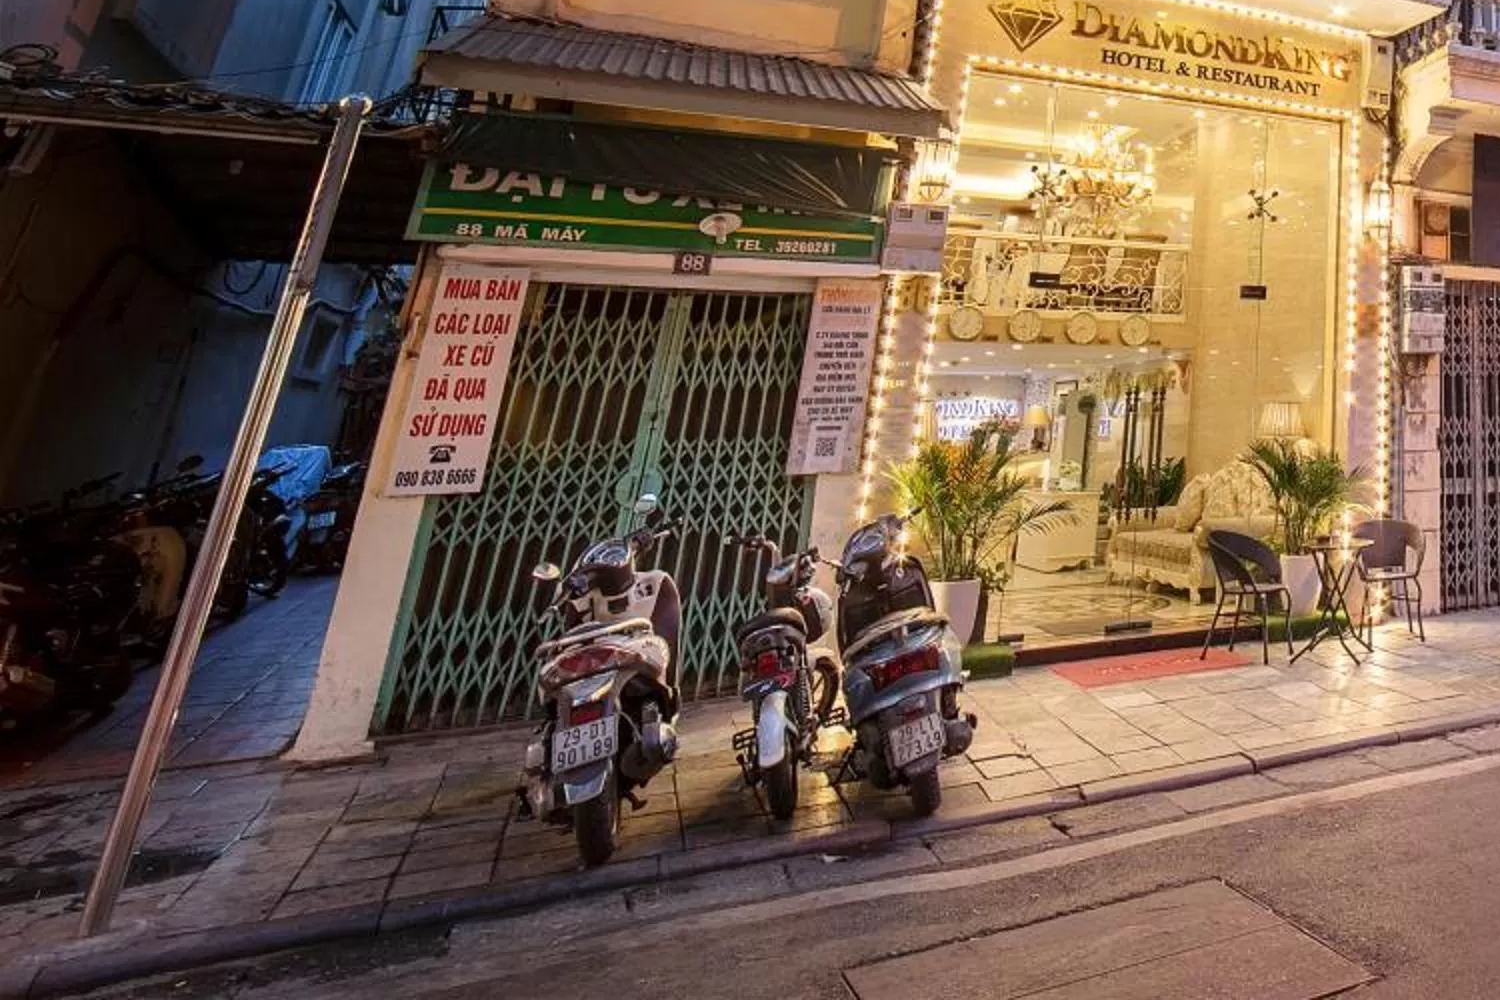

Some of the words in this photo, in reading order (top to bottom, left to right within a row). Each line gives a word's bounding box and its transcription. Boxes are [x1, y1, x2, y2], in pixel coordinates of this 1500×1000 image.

[1102, 48, 1171, 75] HOTEL
[1175, 65, 1191, 79] &
[1196, 64, 1322, 99] RESTAURANT
[456, 222, 483, 238] 88
[681, 253, 705, 272] 88
[443, 278, 482, 300] MUA
[434, 306, 470, 334] CÁC
[472, 312, 511, 340] LOẠI
[443, 344, 467, 367] XE
[424, 373, 451, 401] ĐÃ
[453, 377, 487, 402] QUA
[409, 406, 437, 438] SỬ
[437, 413, 487, 442] DỤNG
